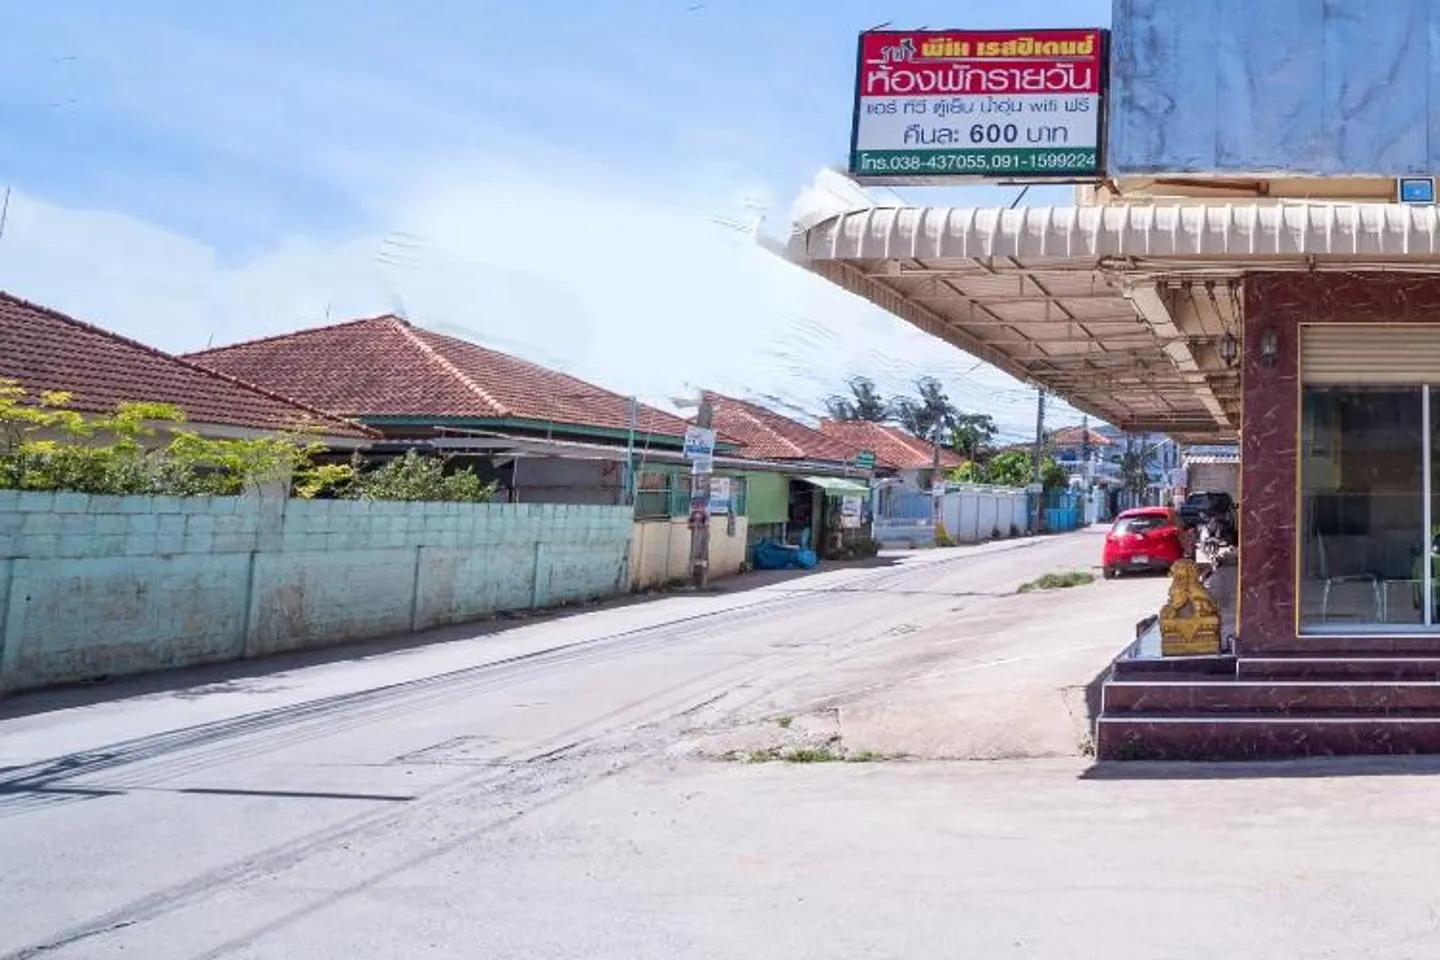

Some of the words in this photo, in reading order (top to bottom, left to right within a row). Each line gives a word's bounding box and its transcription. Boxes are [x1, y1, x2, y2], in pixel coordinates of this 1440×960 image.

[867, 63, 1091, 93] ห้องพักรายวัน
[867, 100, 897, 114] แอร์
[904, 99, 926, 114] ทีวี
[933, 98, 974, 118] ตู้เย็น
[980, 96, 1022, 116] น้ำอุ่น
[1064, 97, 1089, 112] ฟรี
[903, 124, 959, 144] คืนละ
[970, 124, 1018, 143] 600
[1027, 126, 1068, 143] บาท
